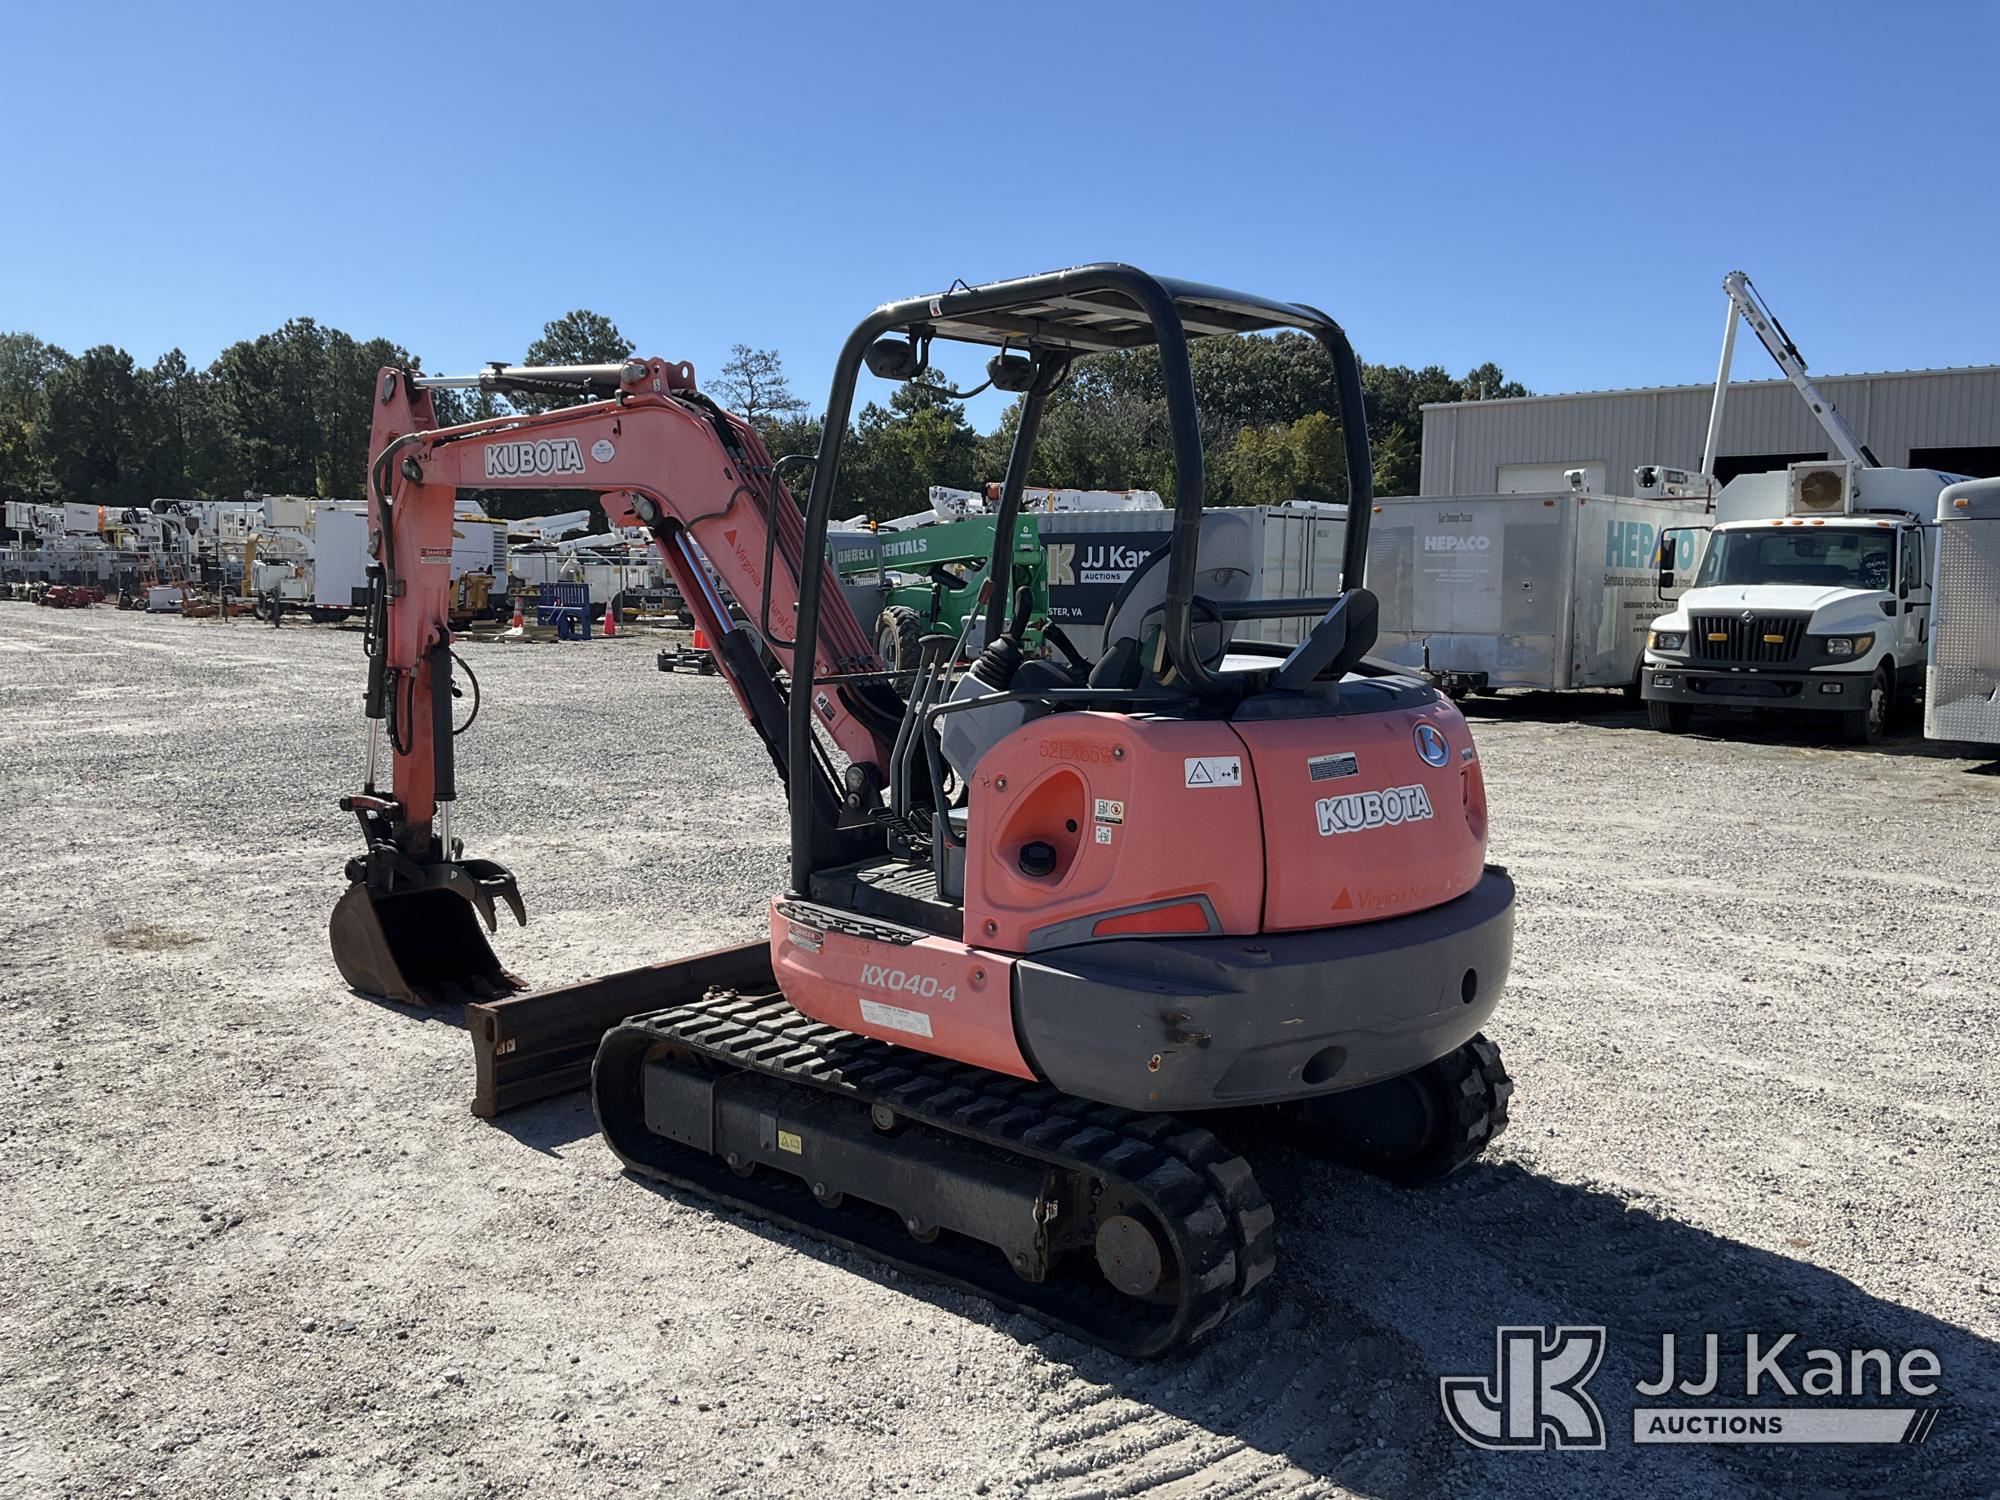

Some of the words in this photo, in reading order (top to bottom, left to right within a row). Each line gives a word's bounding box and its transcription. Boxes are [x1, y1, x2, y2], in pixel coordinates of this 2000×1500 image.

[486, 439, 585, 477] KUBOTA
[837, 548, 874, 563] UNBELT
[1081, 546, 1104, 568] JJ
[1425, 536, 1490, 550] HEPACO
[1605, 520, 1694, 571] HEPAO
[1072, 608, 1083, 616] VA
[1317, 785, 1432, 834] KUBOTA
[861, 963, 957, 1002] KX040-4
